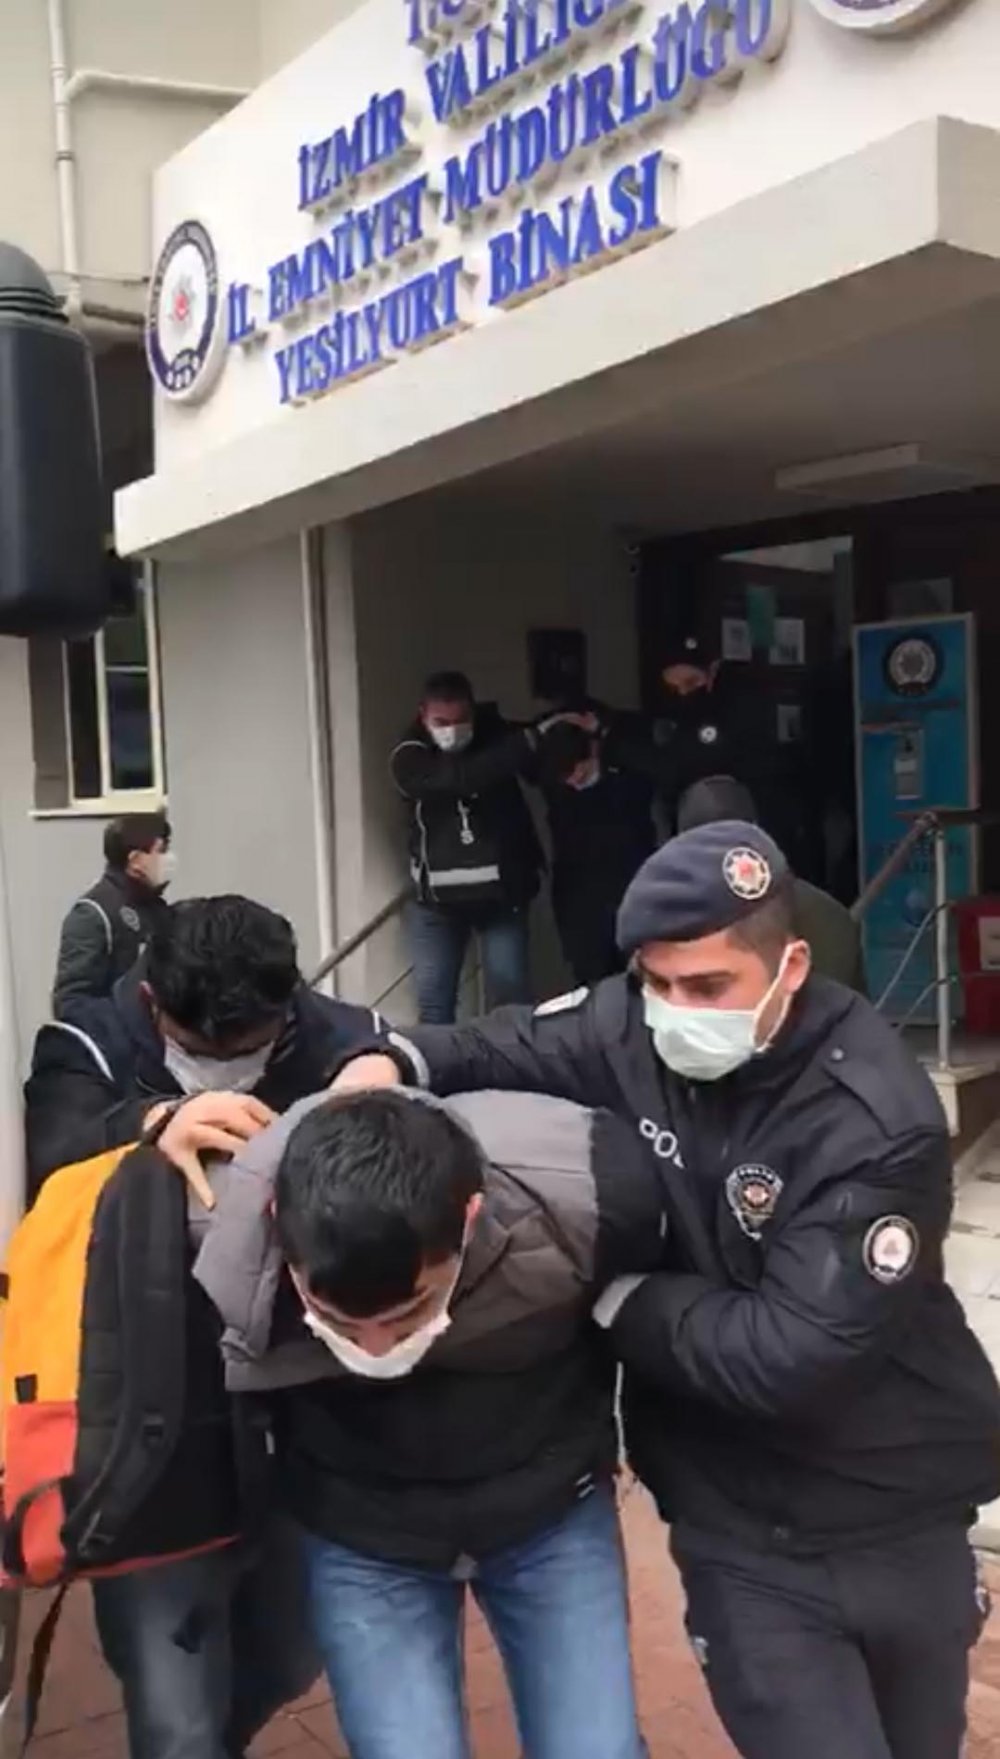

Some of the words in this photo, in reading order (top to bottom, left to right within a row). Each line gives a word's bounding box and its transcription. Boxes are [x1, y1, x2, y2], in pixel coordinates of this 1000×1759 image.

[297, 87, 409, 211] İZMİR
[488, 149, 664, 306] BİNASI
[228, 279, 256, 344] İL
[267, 172, 429, 322] EMNİYET
